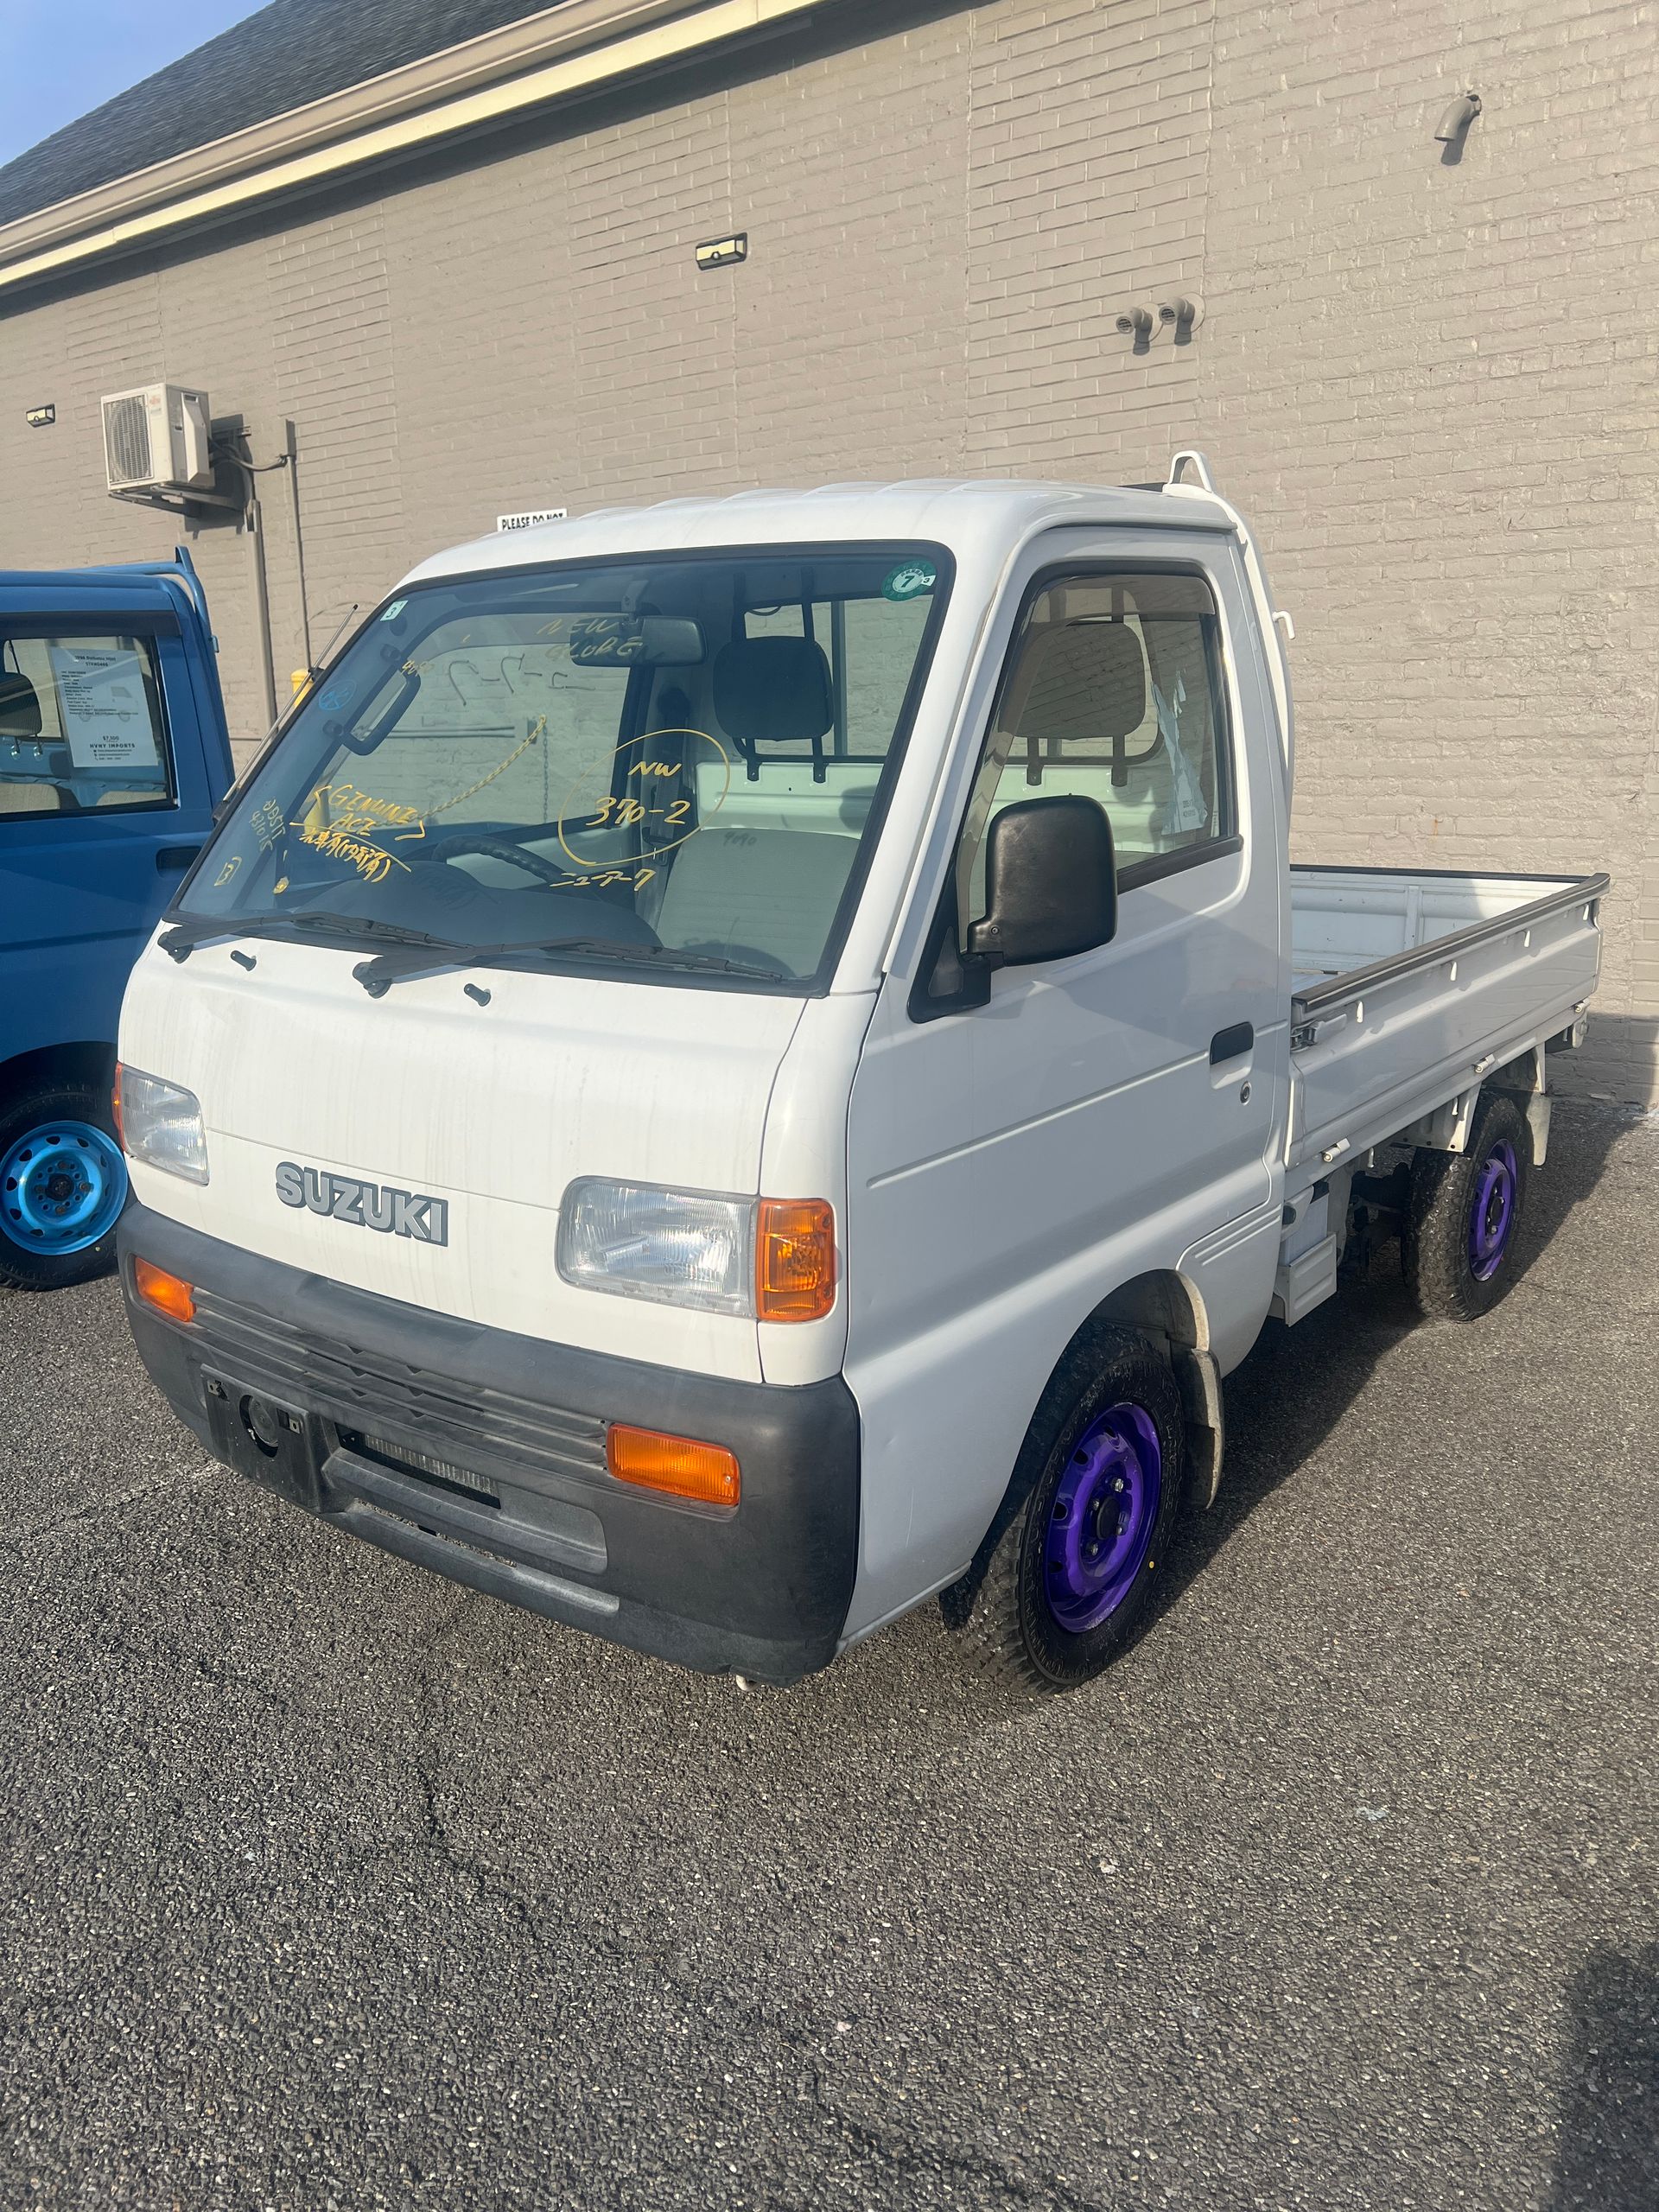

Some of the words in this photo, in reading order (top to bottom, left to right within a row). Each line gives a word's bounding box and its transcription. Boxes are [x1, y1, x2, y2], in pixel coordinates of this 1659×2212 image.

[502, 516, 531, 530] PLEASE
[901, 575, 916, 588] 7
[627, 761, 682, 777] NW
[275, 1161, 448, 1248] SUZUKI
